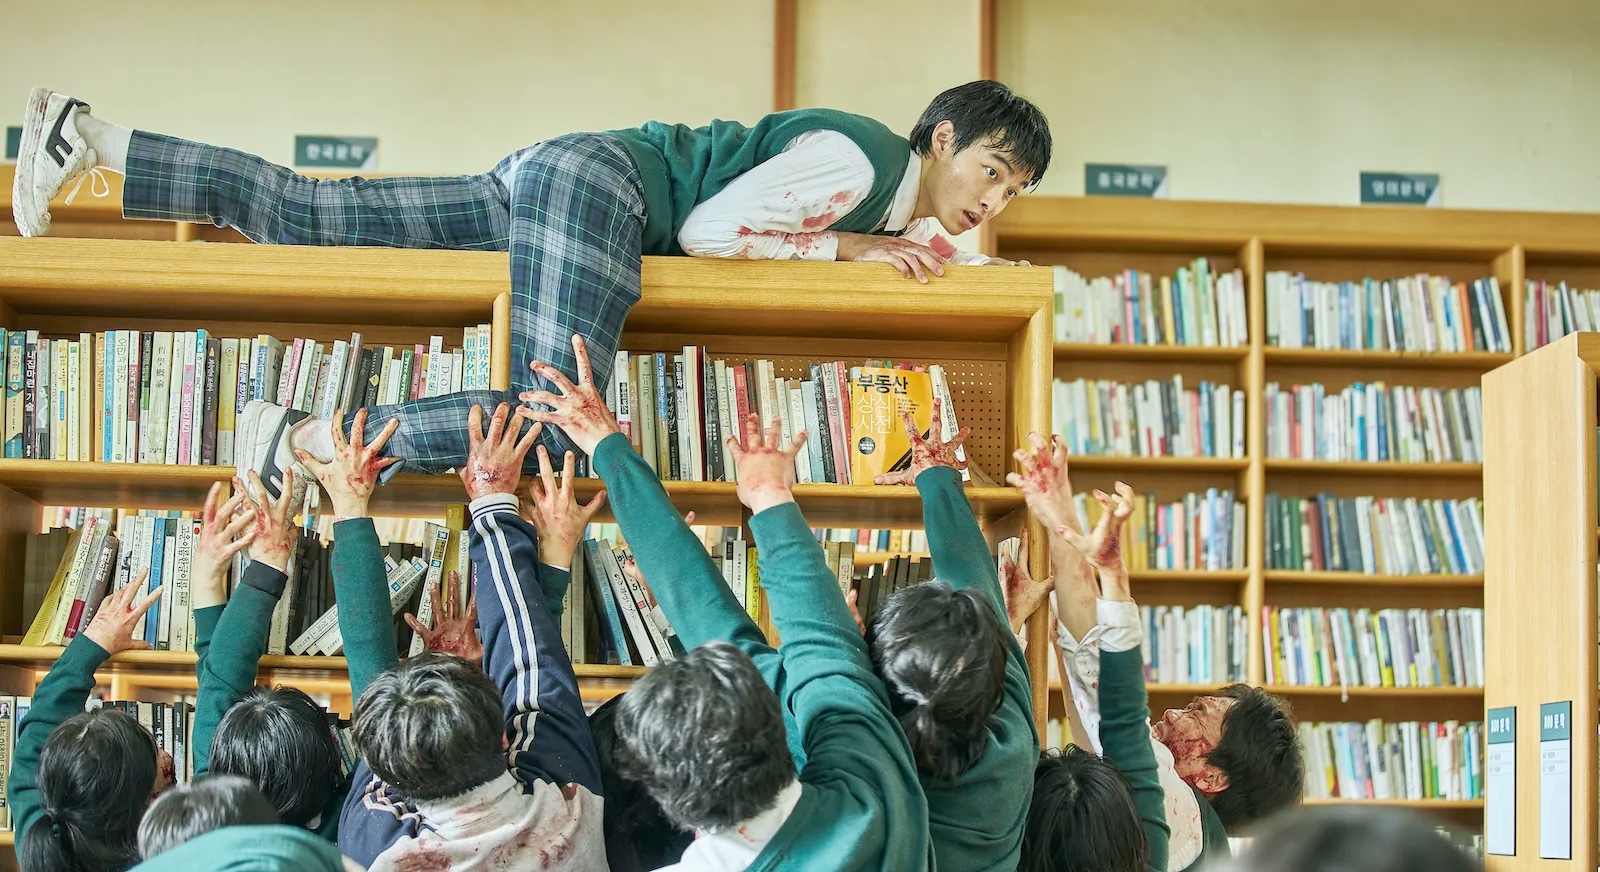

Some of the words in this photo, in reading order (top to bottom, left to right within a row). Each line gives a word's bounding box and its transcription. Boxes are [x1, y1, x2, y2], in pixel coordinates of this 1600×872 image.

[26, 350, 36, 388] 내집마련
[428, 345, 440, 391] 교육학개론
[465, 338, 475, 390] 世界名歌
[478, 336, 489, 390] 世界名歌
[857, 374, 908, 394] 부동산
[857, 394, 890, 414] 상식
[857, 414, 891, 434] 사전
